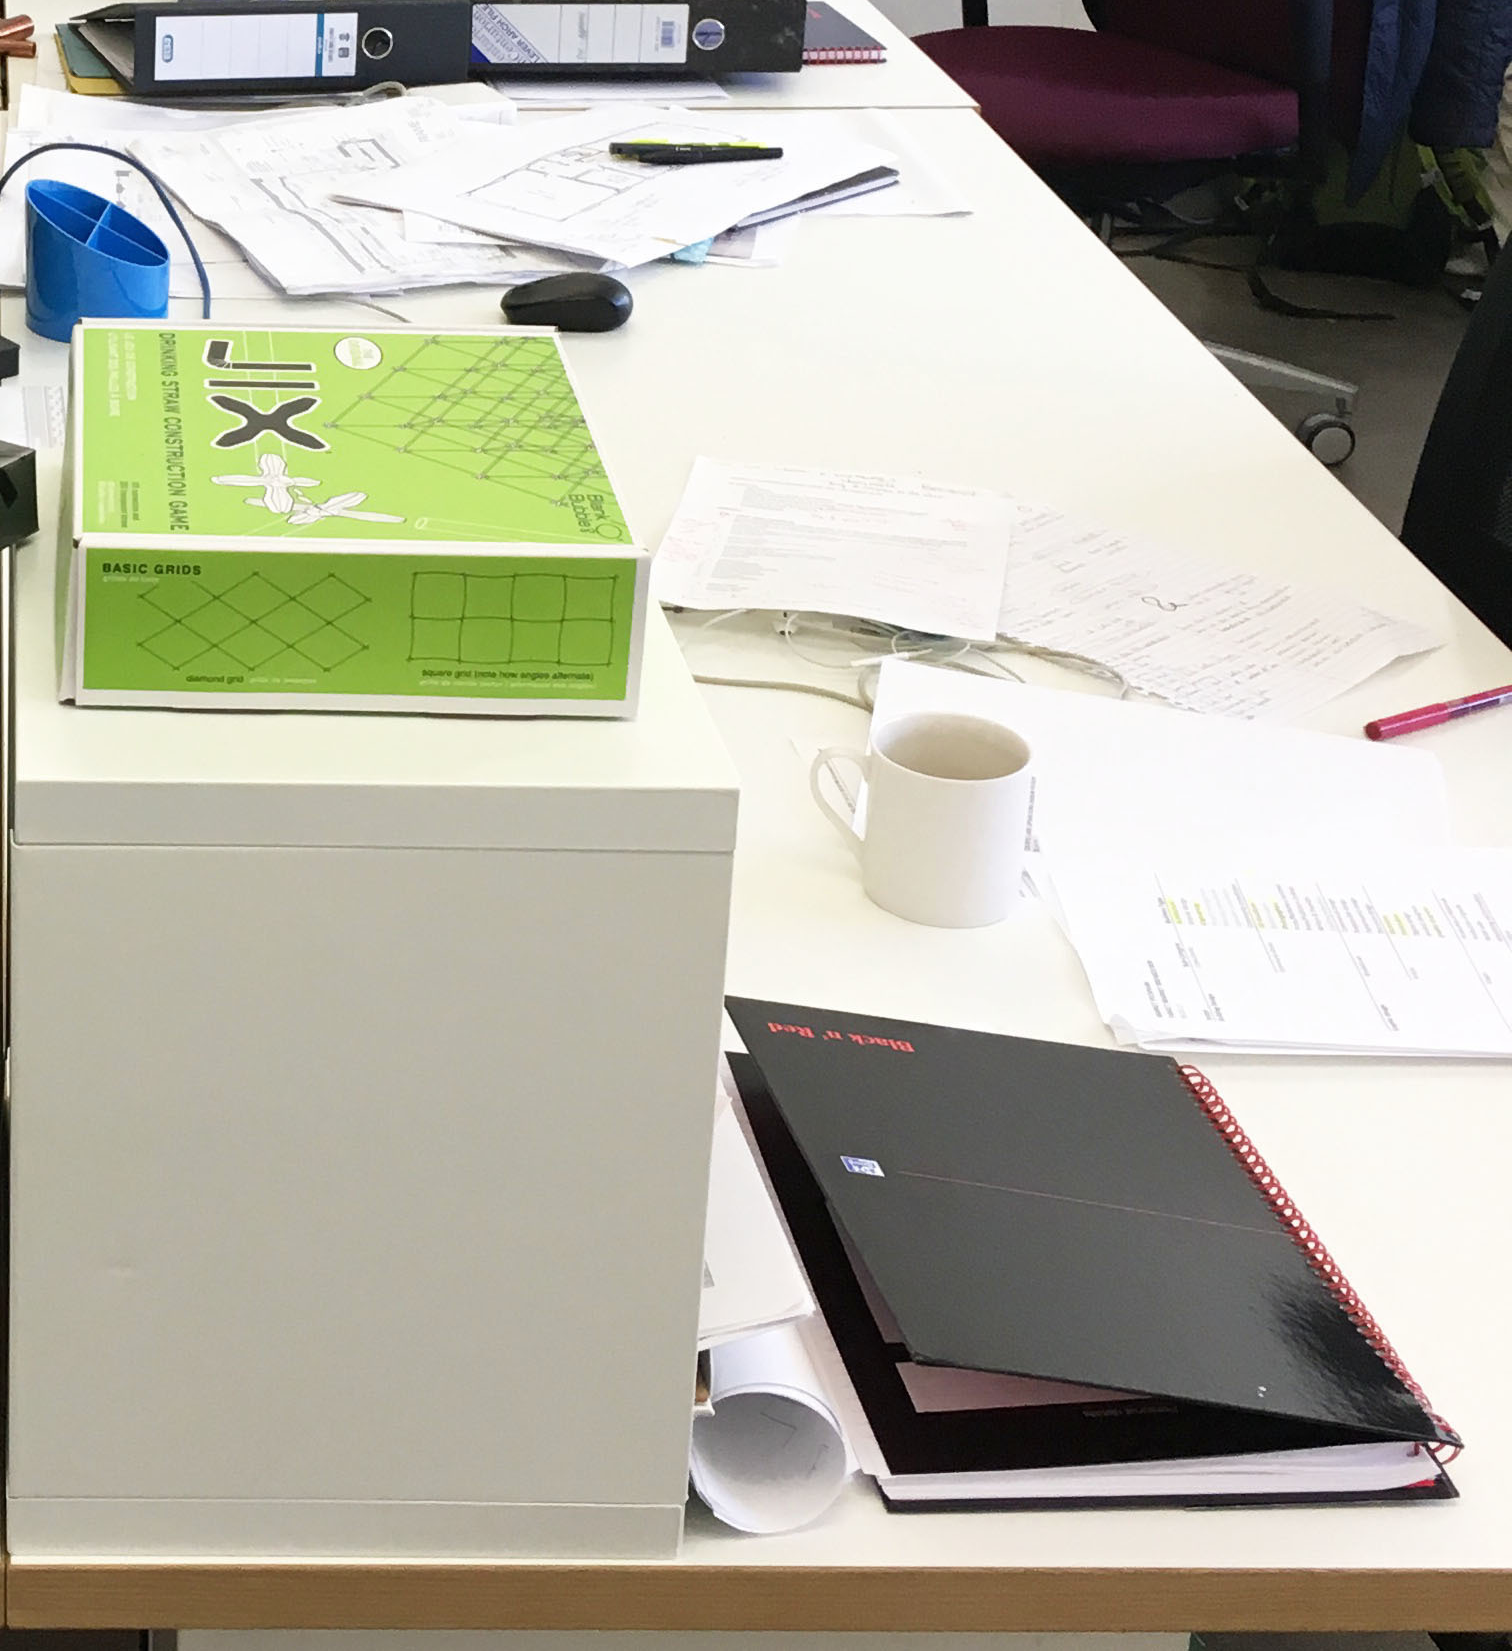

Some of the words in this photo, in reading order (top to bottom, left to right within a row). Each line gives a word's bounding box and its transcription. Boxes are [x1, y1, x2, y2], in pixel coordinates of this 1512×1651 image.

[482, 4, 499, 20] FILE
[496, 18, 518, 39] ARCH
[517, 39, 540, 63] LEVER
[159, 333, 178, 377] DRINKING
[162, 381, 181, 414] STRAW
[204, 339, 329, 451] JIX
[164, 417, 186, 496] CONSTRUCTION
[169, 501, 189, 531] GAME
[102, 563, 148, 574] BASIC
[154, 564, 201, 576] GRIDS
[186, 673, 225, 683] diamond
[226, 674, 244, 685] grid
[768, 1022, 815, 1039] Red
[847, 1033, 916, 1053] Black
